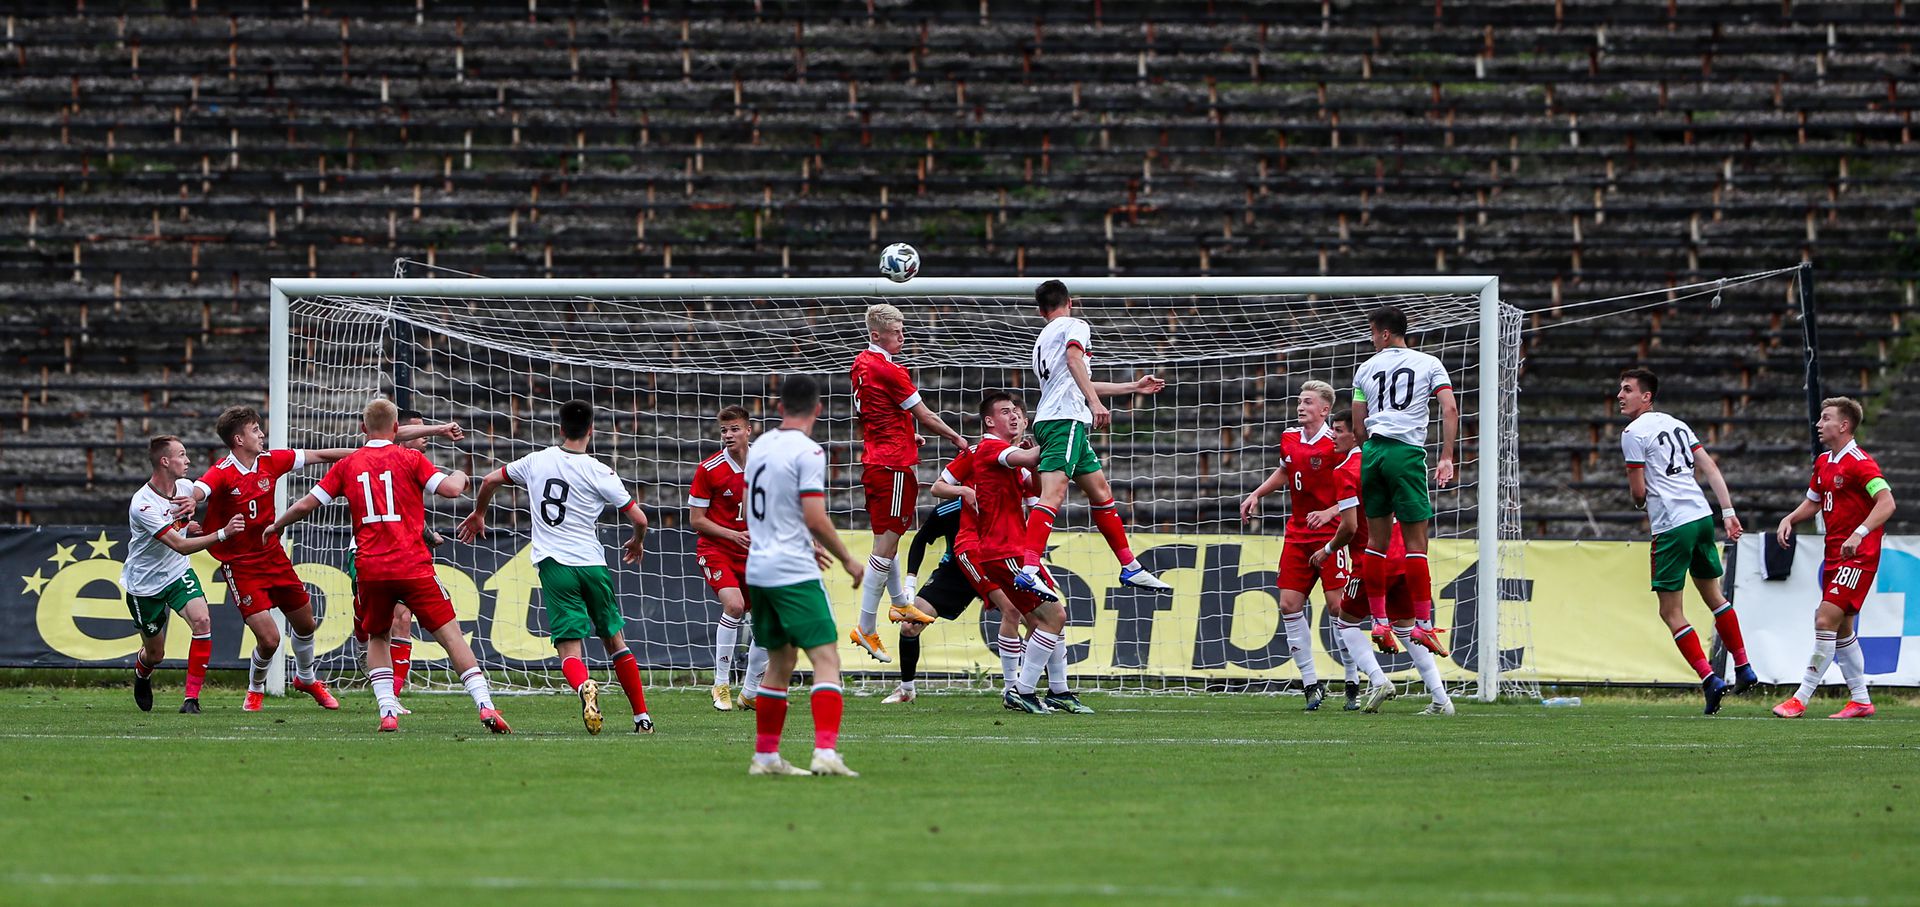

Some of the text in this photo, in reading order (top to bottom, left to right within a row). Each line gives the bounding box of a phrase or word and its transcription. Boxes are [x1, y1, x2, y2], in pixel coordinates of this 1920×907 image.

[1037, 345, 1050, 382] 4
[1372, 367, 1415, 412] 10
[1657, 427, 1694, 476] 20
[357, 470, 402, 524] 11
[752, 463, 767, 522] 6
[1294, 471, 1302, 491] 6
[249, 499, 257, 520] 9
[541, 478, 570, 527] 8
[1336, 550, 1344, 569] 6
[1832, 566, 1850, 586] 18
[182, 574, 195, 589] 5
